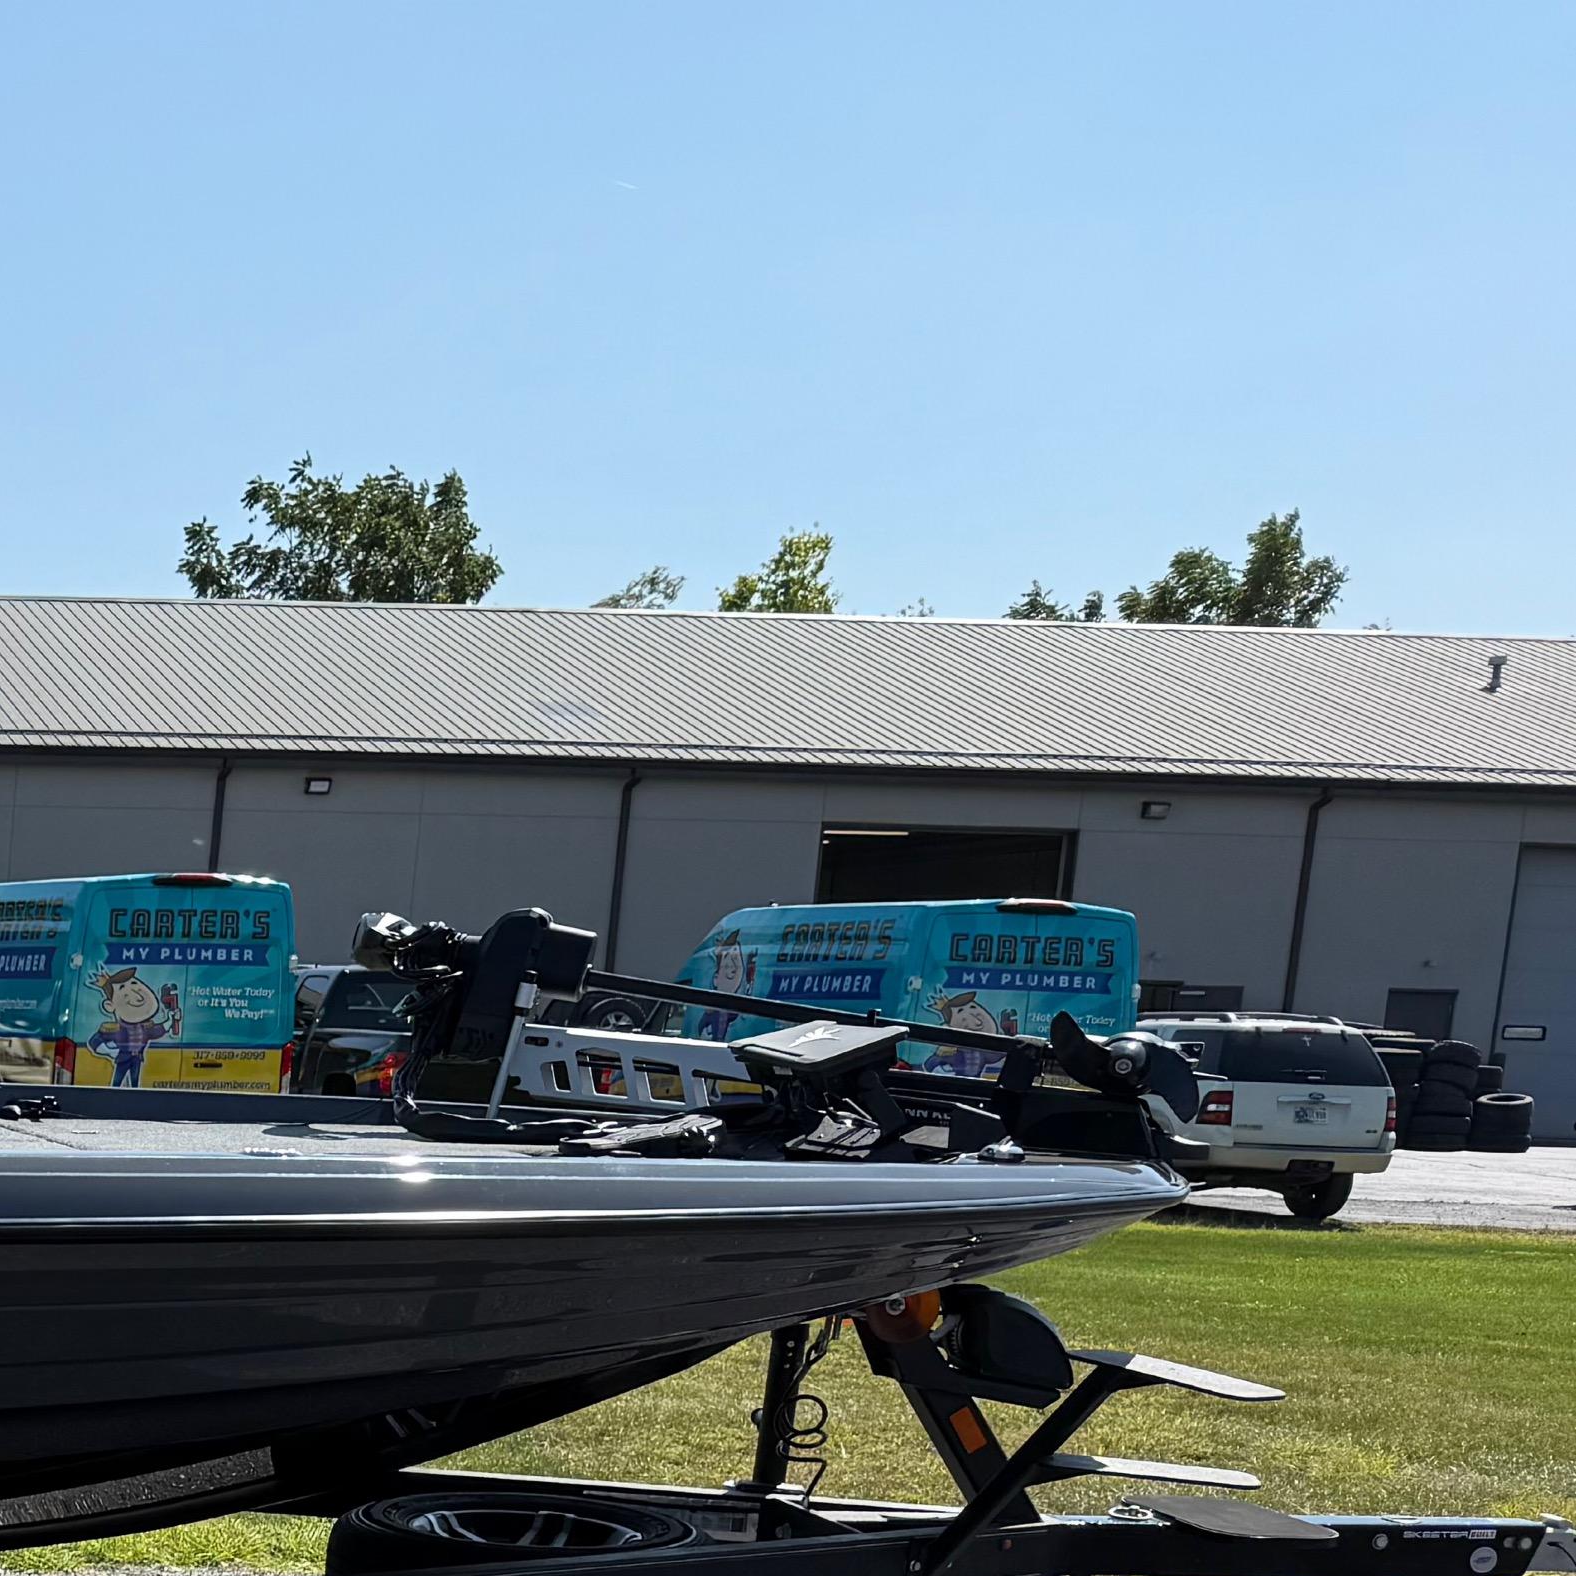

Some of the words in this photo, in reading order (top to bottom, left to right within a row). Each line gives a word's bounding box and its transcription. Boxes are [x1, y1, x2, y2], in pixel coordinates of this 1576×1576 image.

[109, 908, 271, 939] CARTER'S
[122, 948, 150, 961] MY
[160, 948, 254, 962] PLUMBER
[949, 932, 1115, 968] CARTER'S
[778, 975, 799, 992] MY
[803, 975, 872, 993] PLUMBER
[962, 971, 990, 985] MY
[1001, 972, 1096, 989] PLUMBER
[244, 987, 275, 999] Today
[229, 998, 249, 1008] You
[1402, 1530, 1469, 1539] SKEETER
